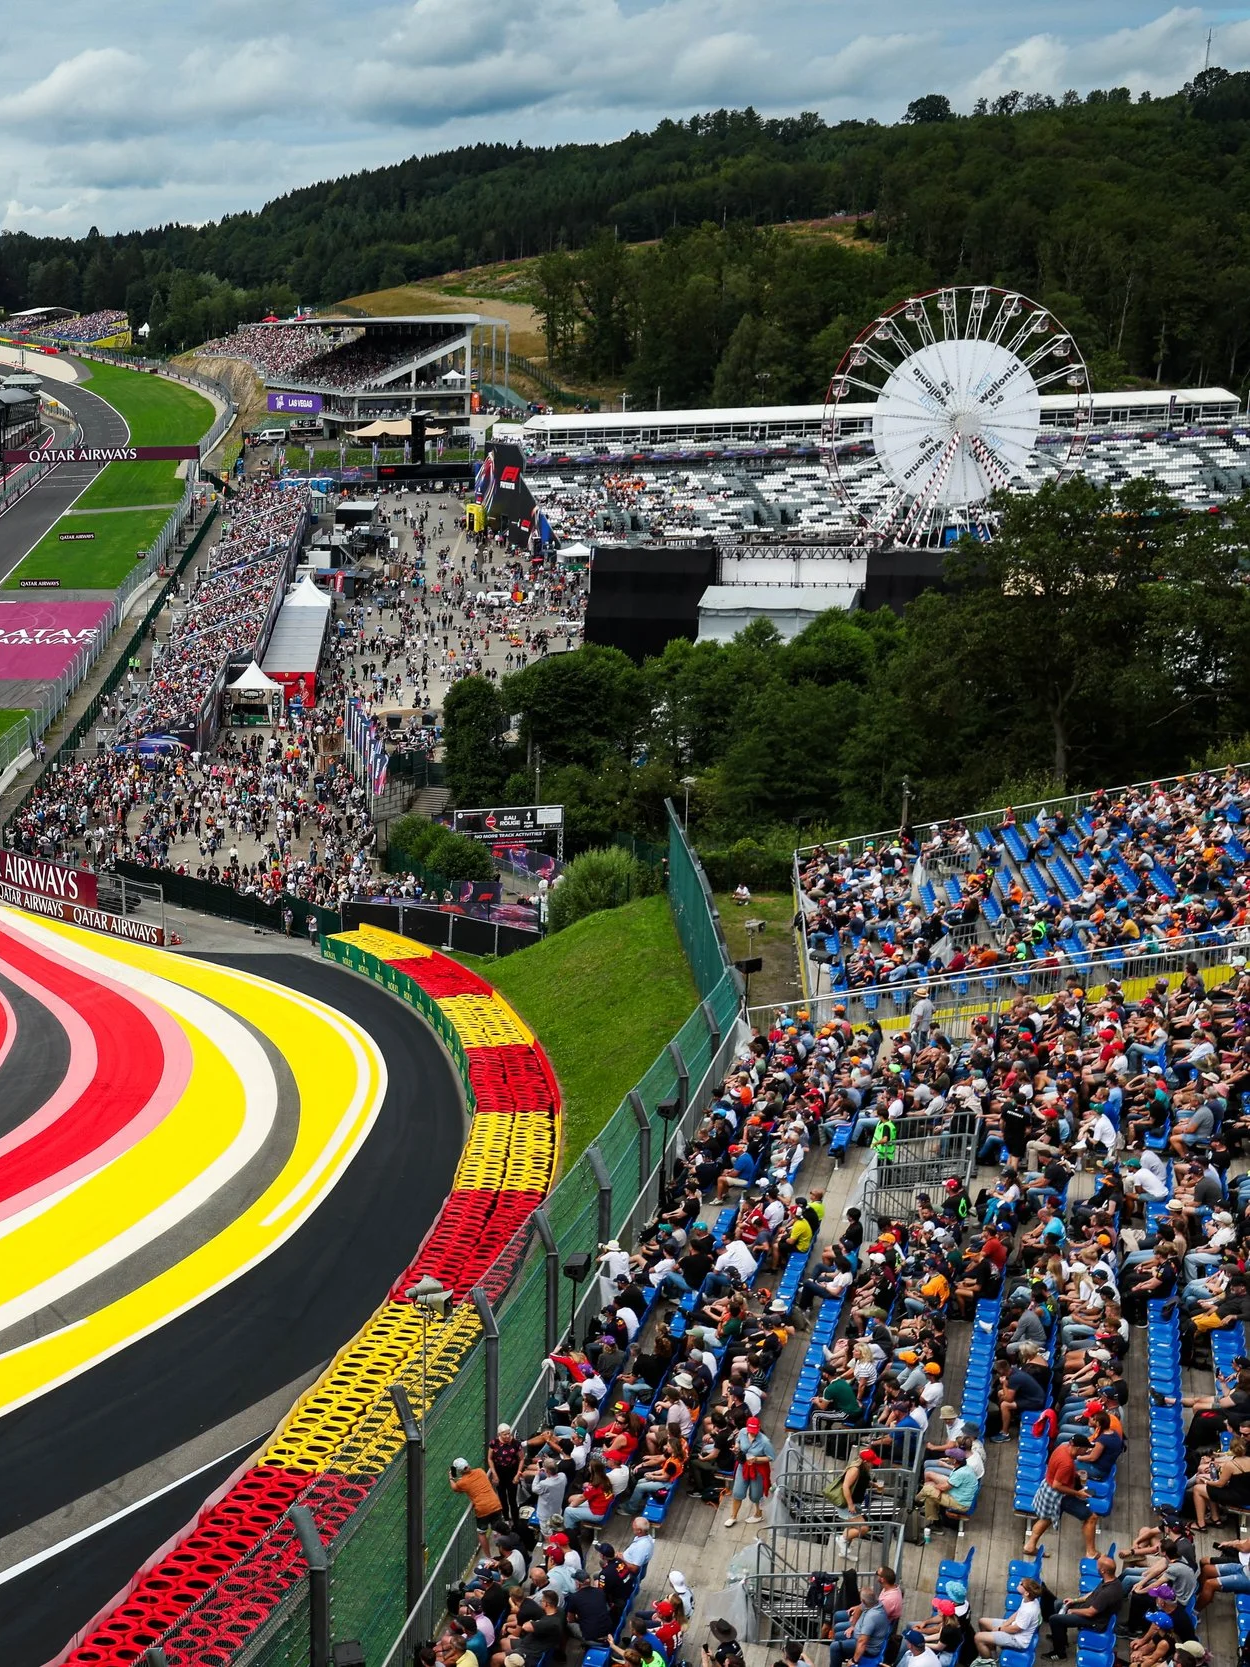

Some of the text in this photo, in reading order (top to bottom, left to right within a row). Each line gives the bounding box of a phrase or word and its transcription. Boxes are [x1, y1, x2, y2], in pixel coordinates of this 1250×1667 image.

[913, 367, 947, 408] wallonia
[979, 363, 1020, 404] wallonia
[288, 398, 298, 407] LAS
[298, 399, 313, 408] VEGAS
[29, 448, 137, 462] QATAR AIRWAYS
[904, 439, 944, 480] wallonia
[5, 853, 79, 900] AIRWAYS
[24, 893, 64, 918] AIRWAYS
[73, 907, 158, 944] QATAR AIRWAYS
[323, 951, 336, 961] ROLEX
[342, 957, 353, 968] ROLEX
